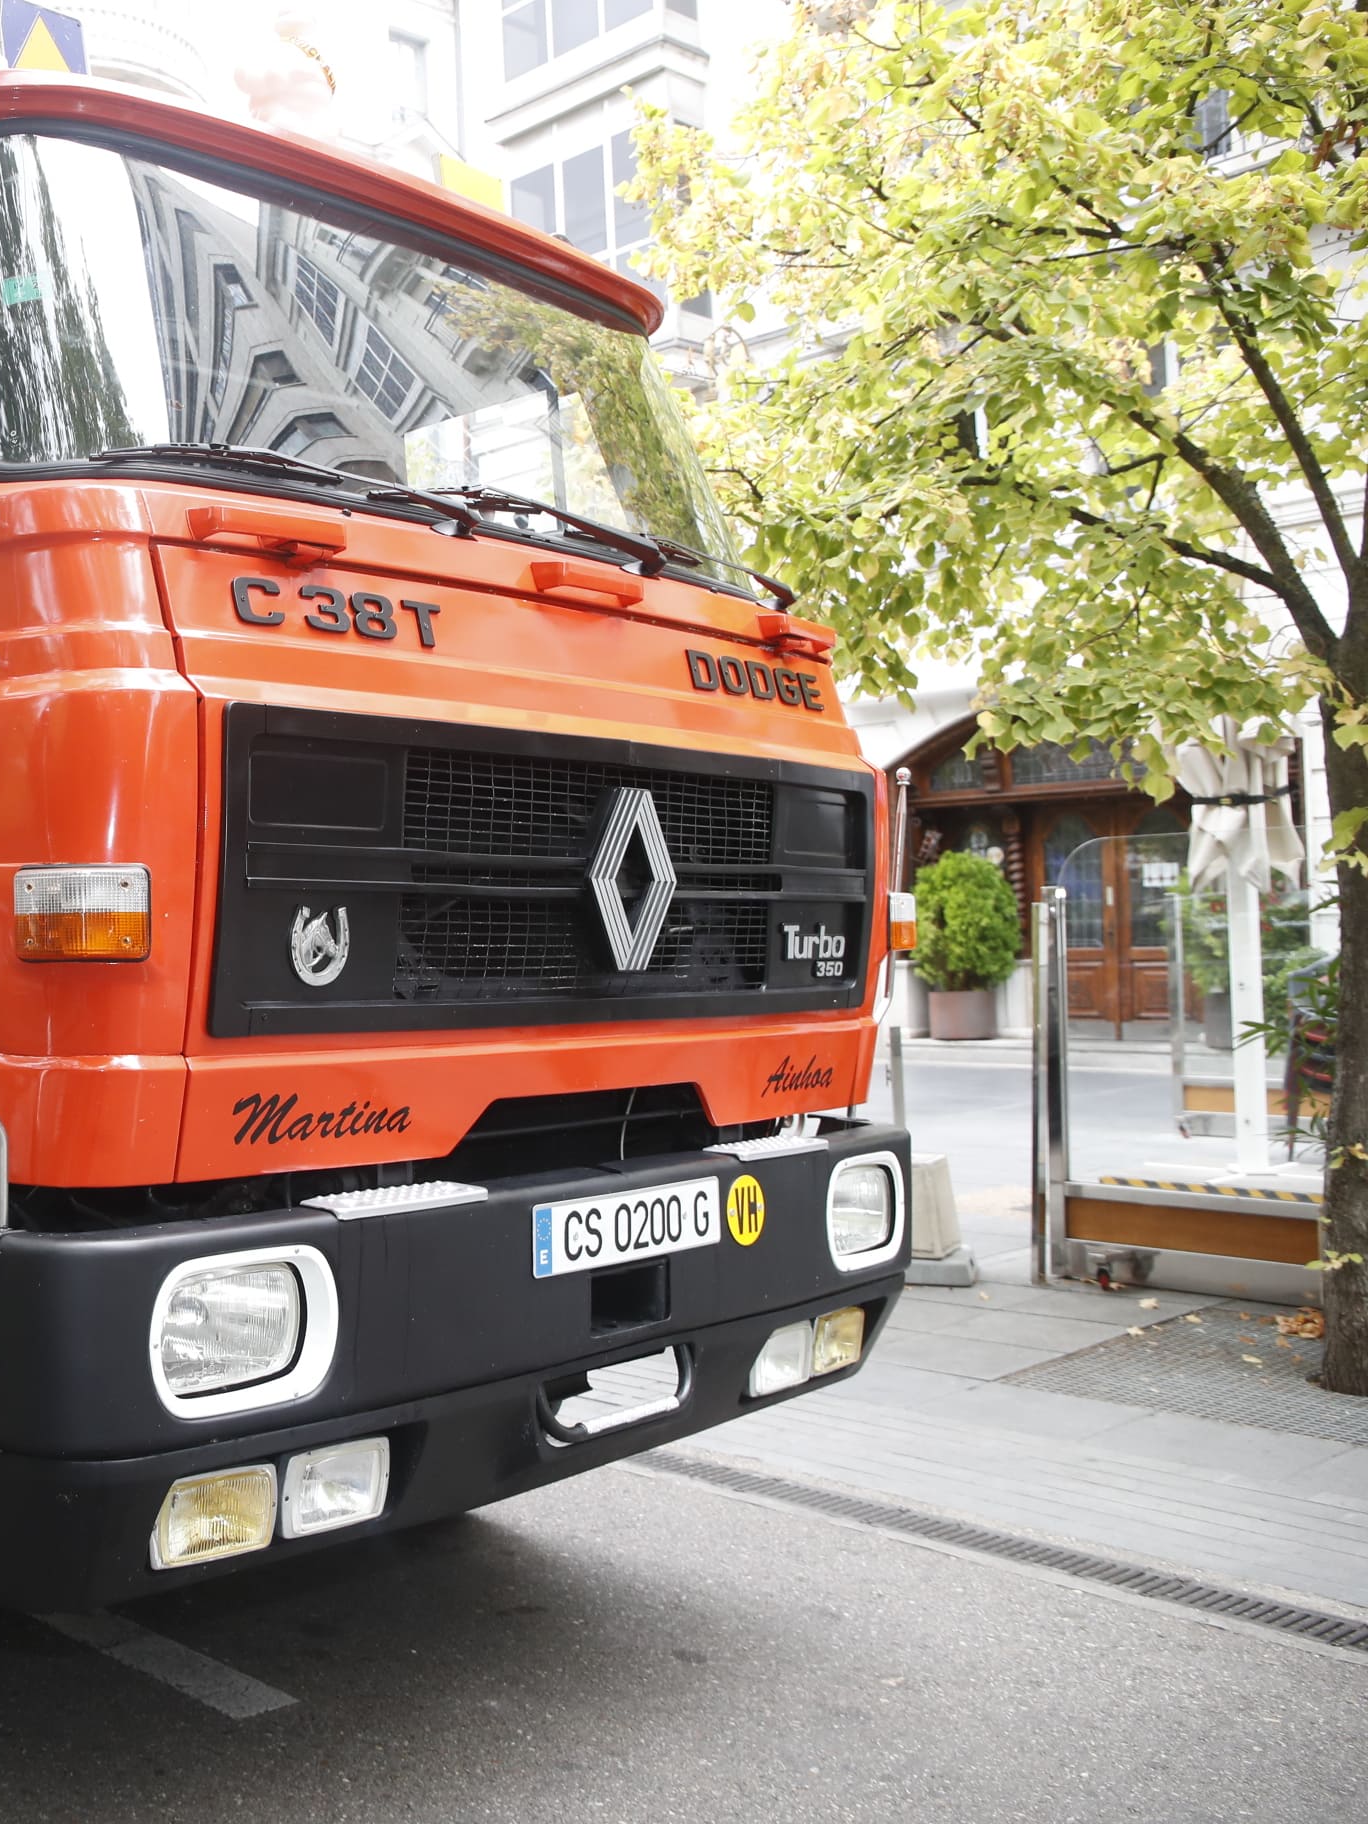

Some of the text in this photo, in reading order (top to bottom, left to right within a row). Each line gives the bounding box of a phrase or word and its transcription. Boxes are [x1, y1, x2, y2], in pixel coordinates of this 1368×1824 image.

[232, 576, 441, 648] C 38T
[685, 649, 824, 712] DODGE
[782, 923, 846, 960] Turbo
[815, 960, 844, 977] 350
[760, 1053, 835, 1098] Ainhoa
[232, 1092, 413, 1146] Martina
[564, 1190, 709, 1262] CS 0200 G
[733, 1184, 758, 1236] VH
[539, 1249, 549, 1265] E
